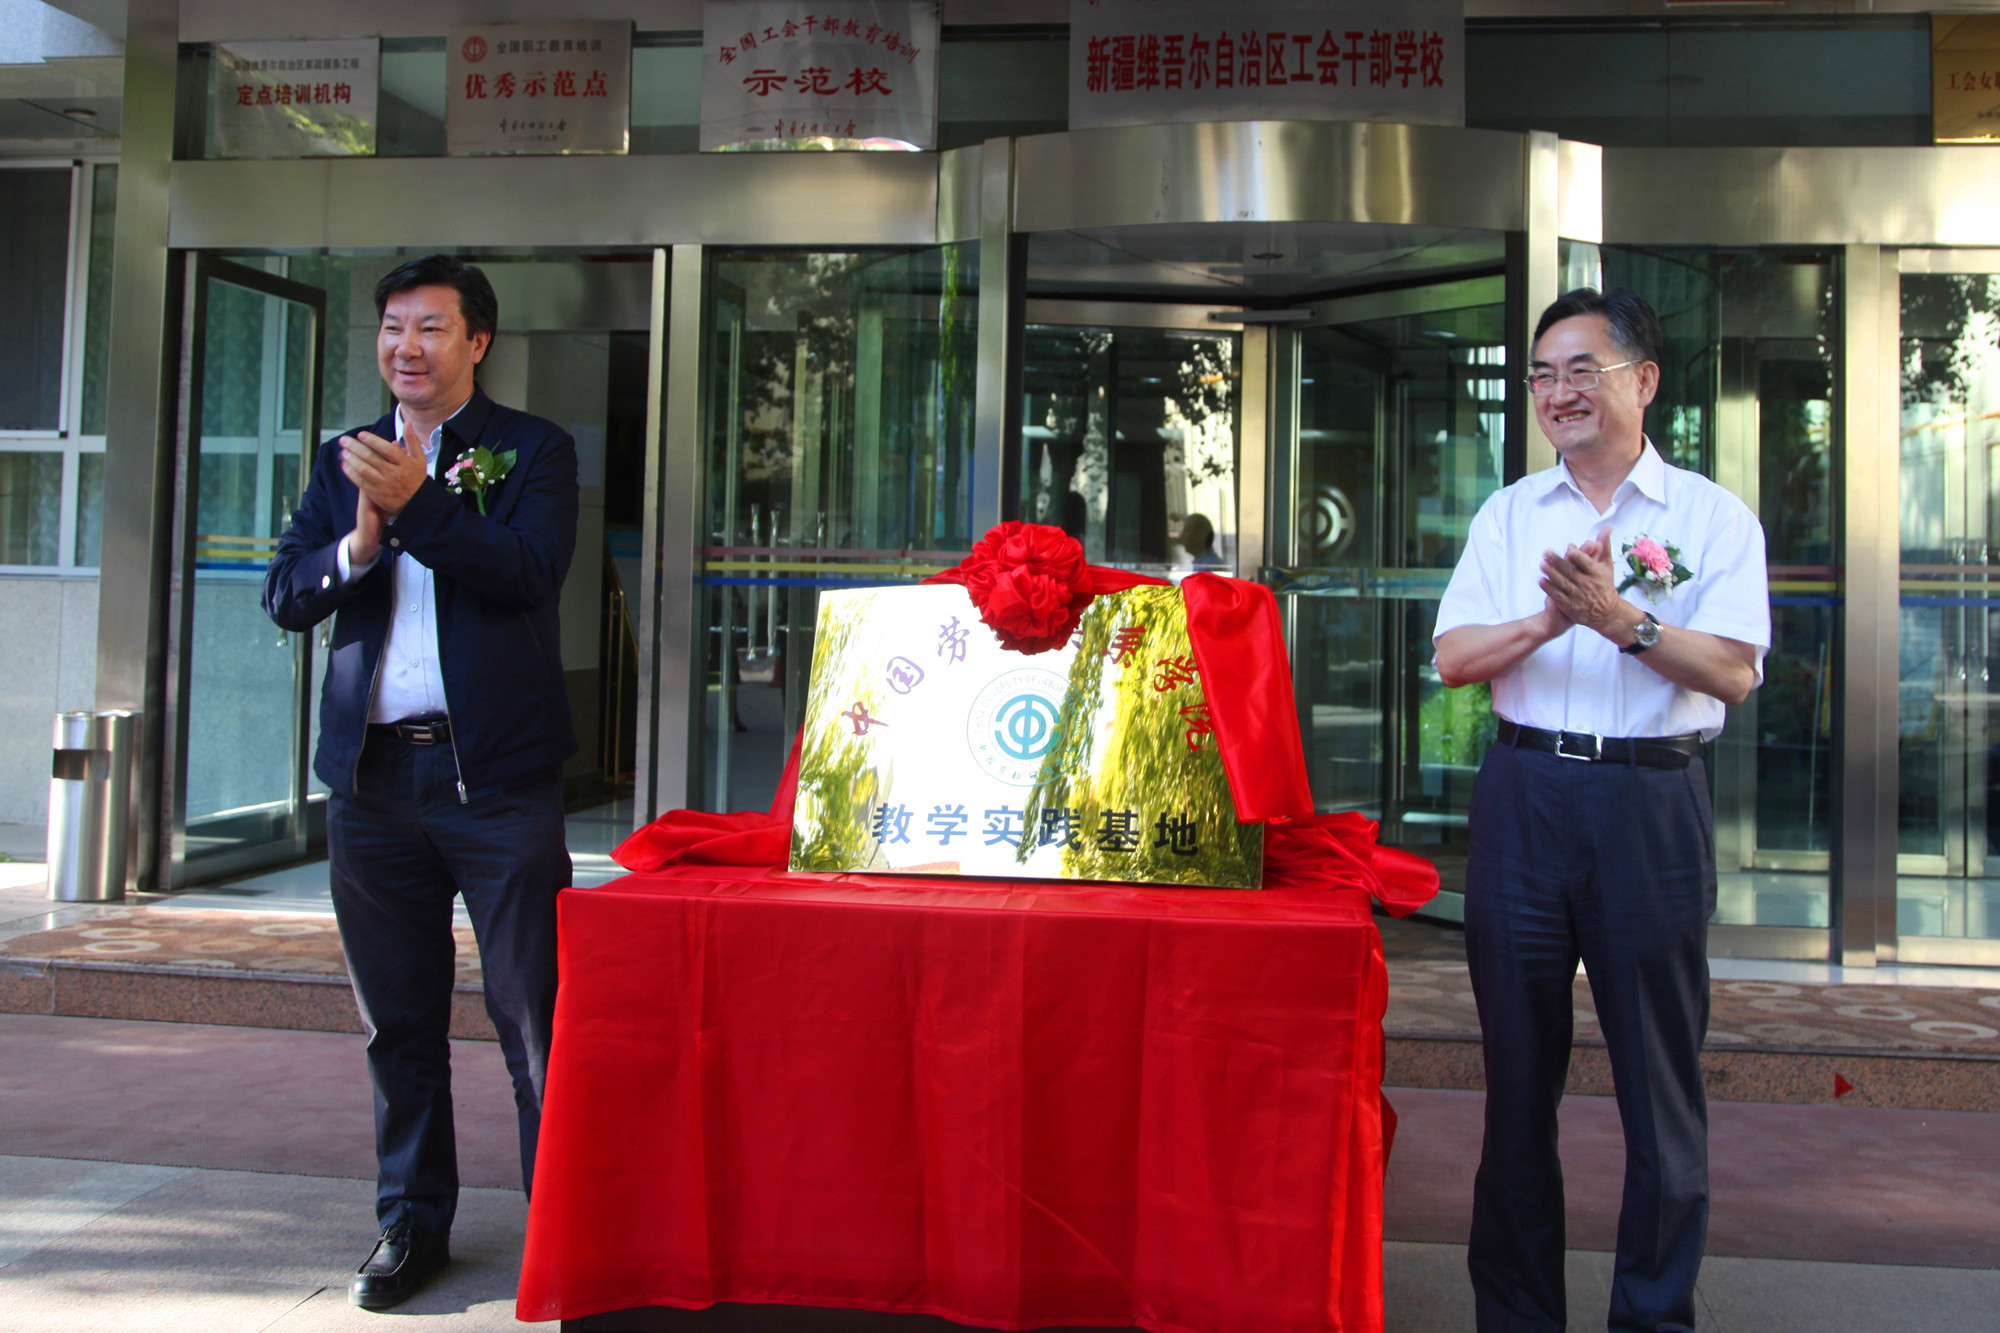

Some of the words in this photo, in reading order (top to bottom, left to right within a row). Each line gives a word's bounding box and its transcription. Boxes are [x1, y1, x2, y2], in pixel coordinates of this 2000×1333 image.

[496, 38, 602, 54] 全国职工教育培训
[718, 14, 921, 66] 全国工会干部教育培训
[742, 66, 893, 97] 示范校
[1086, 29, 1444, 93] 新疆维吾尔自治区工会干部学校
[236, 82, 352, 106] 定点培训机构
[465, 69, 608, 99] 优秀示范点
[840, 615, 1215, 752] 中国劳系学院
[872, 803, 1198, 856] 教学实践基地
